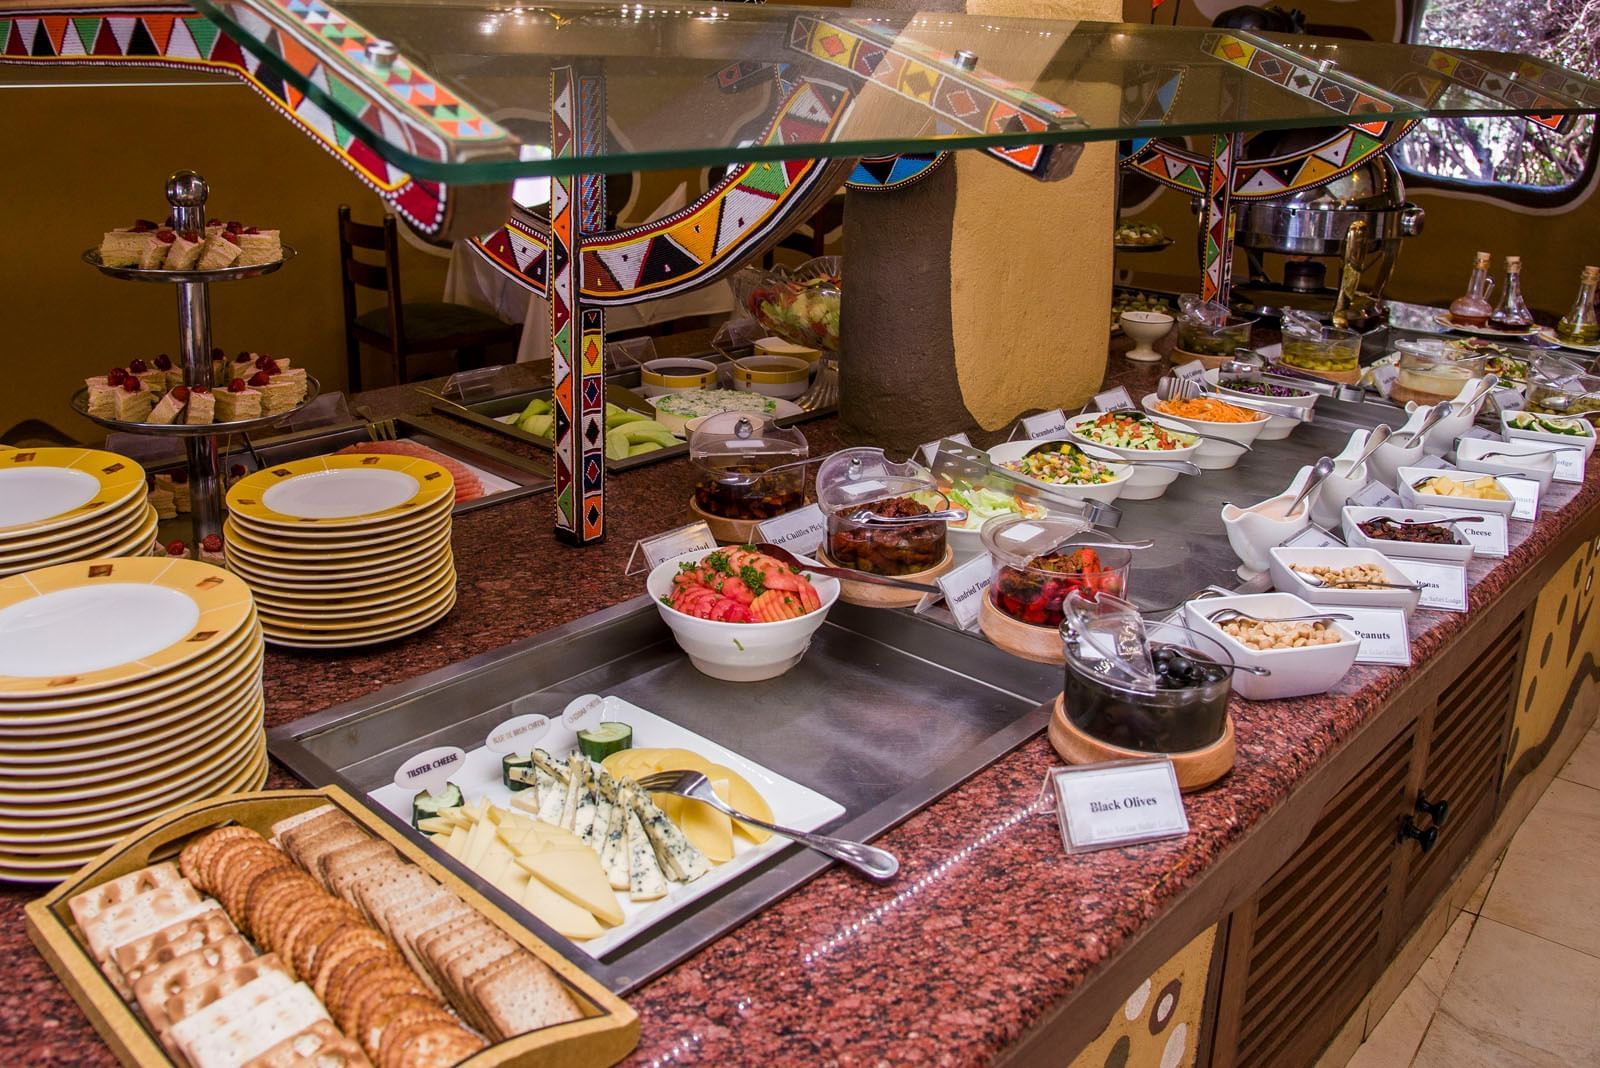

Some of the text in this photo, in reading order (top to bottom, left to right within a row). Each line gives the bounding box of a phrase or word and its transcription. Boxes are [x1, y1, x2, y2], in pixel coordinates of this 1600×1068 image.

[1031, 428, 1054, 438] Cucumber
[1464, 527, 1492, 537] Cheese
[772, 535, 786, 544] Red
[432, 752, 459, 769] CHEESE
[1089, 796, 1158, 813] Black Olives
